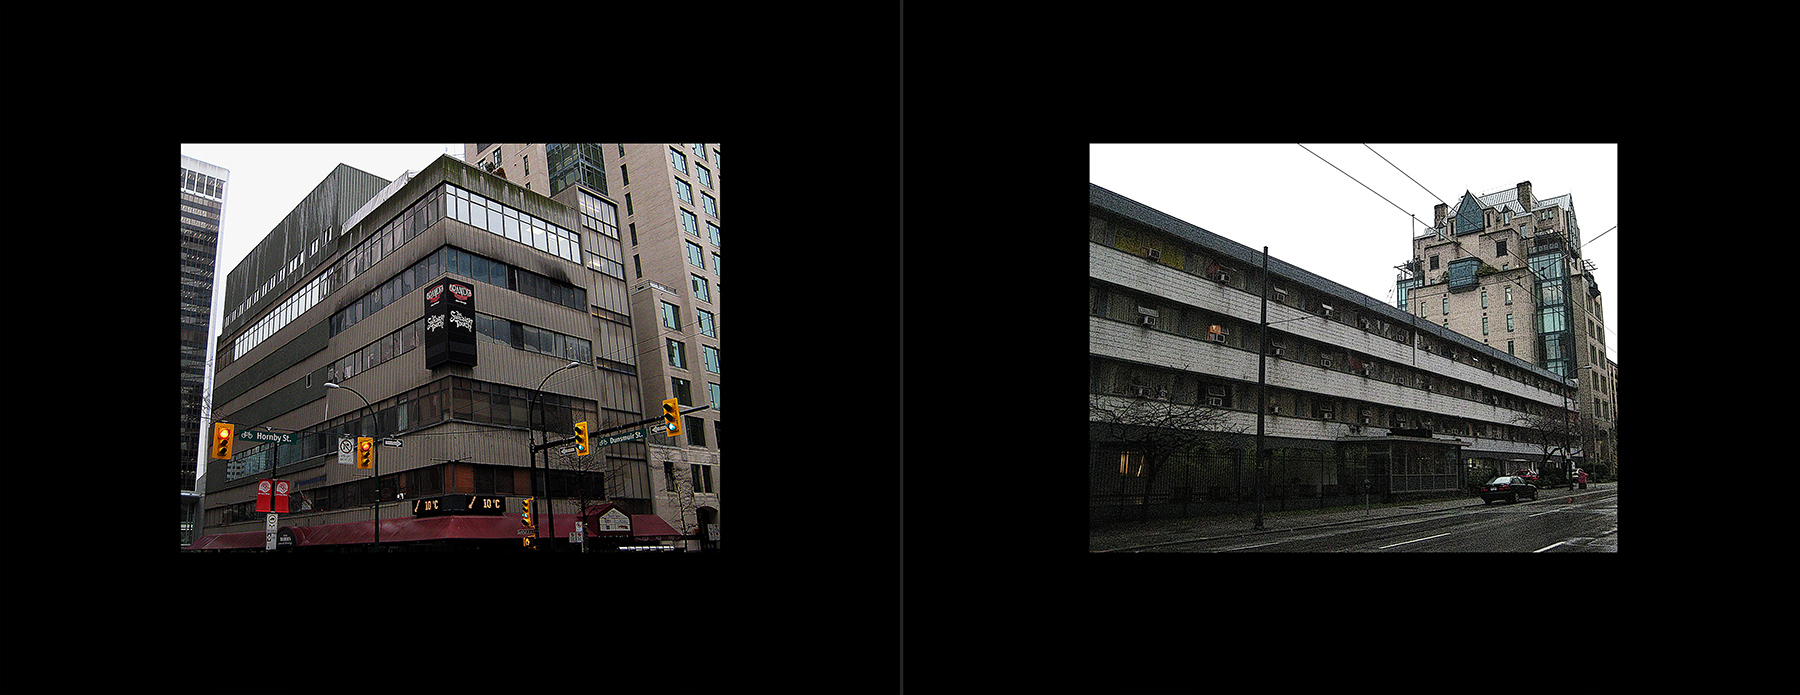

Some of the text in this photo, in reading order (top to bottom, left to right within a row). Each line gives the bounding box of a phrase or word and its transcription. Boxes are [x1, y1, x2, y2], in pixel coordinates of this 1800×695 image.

[256, 432, 292, 443] Hornby St.
[610, 433, 634, 444] Dunsmuir
